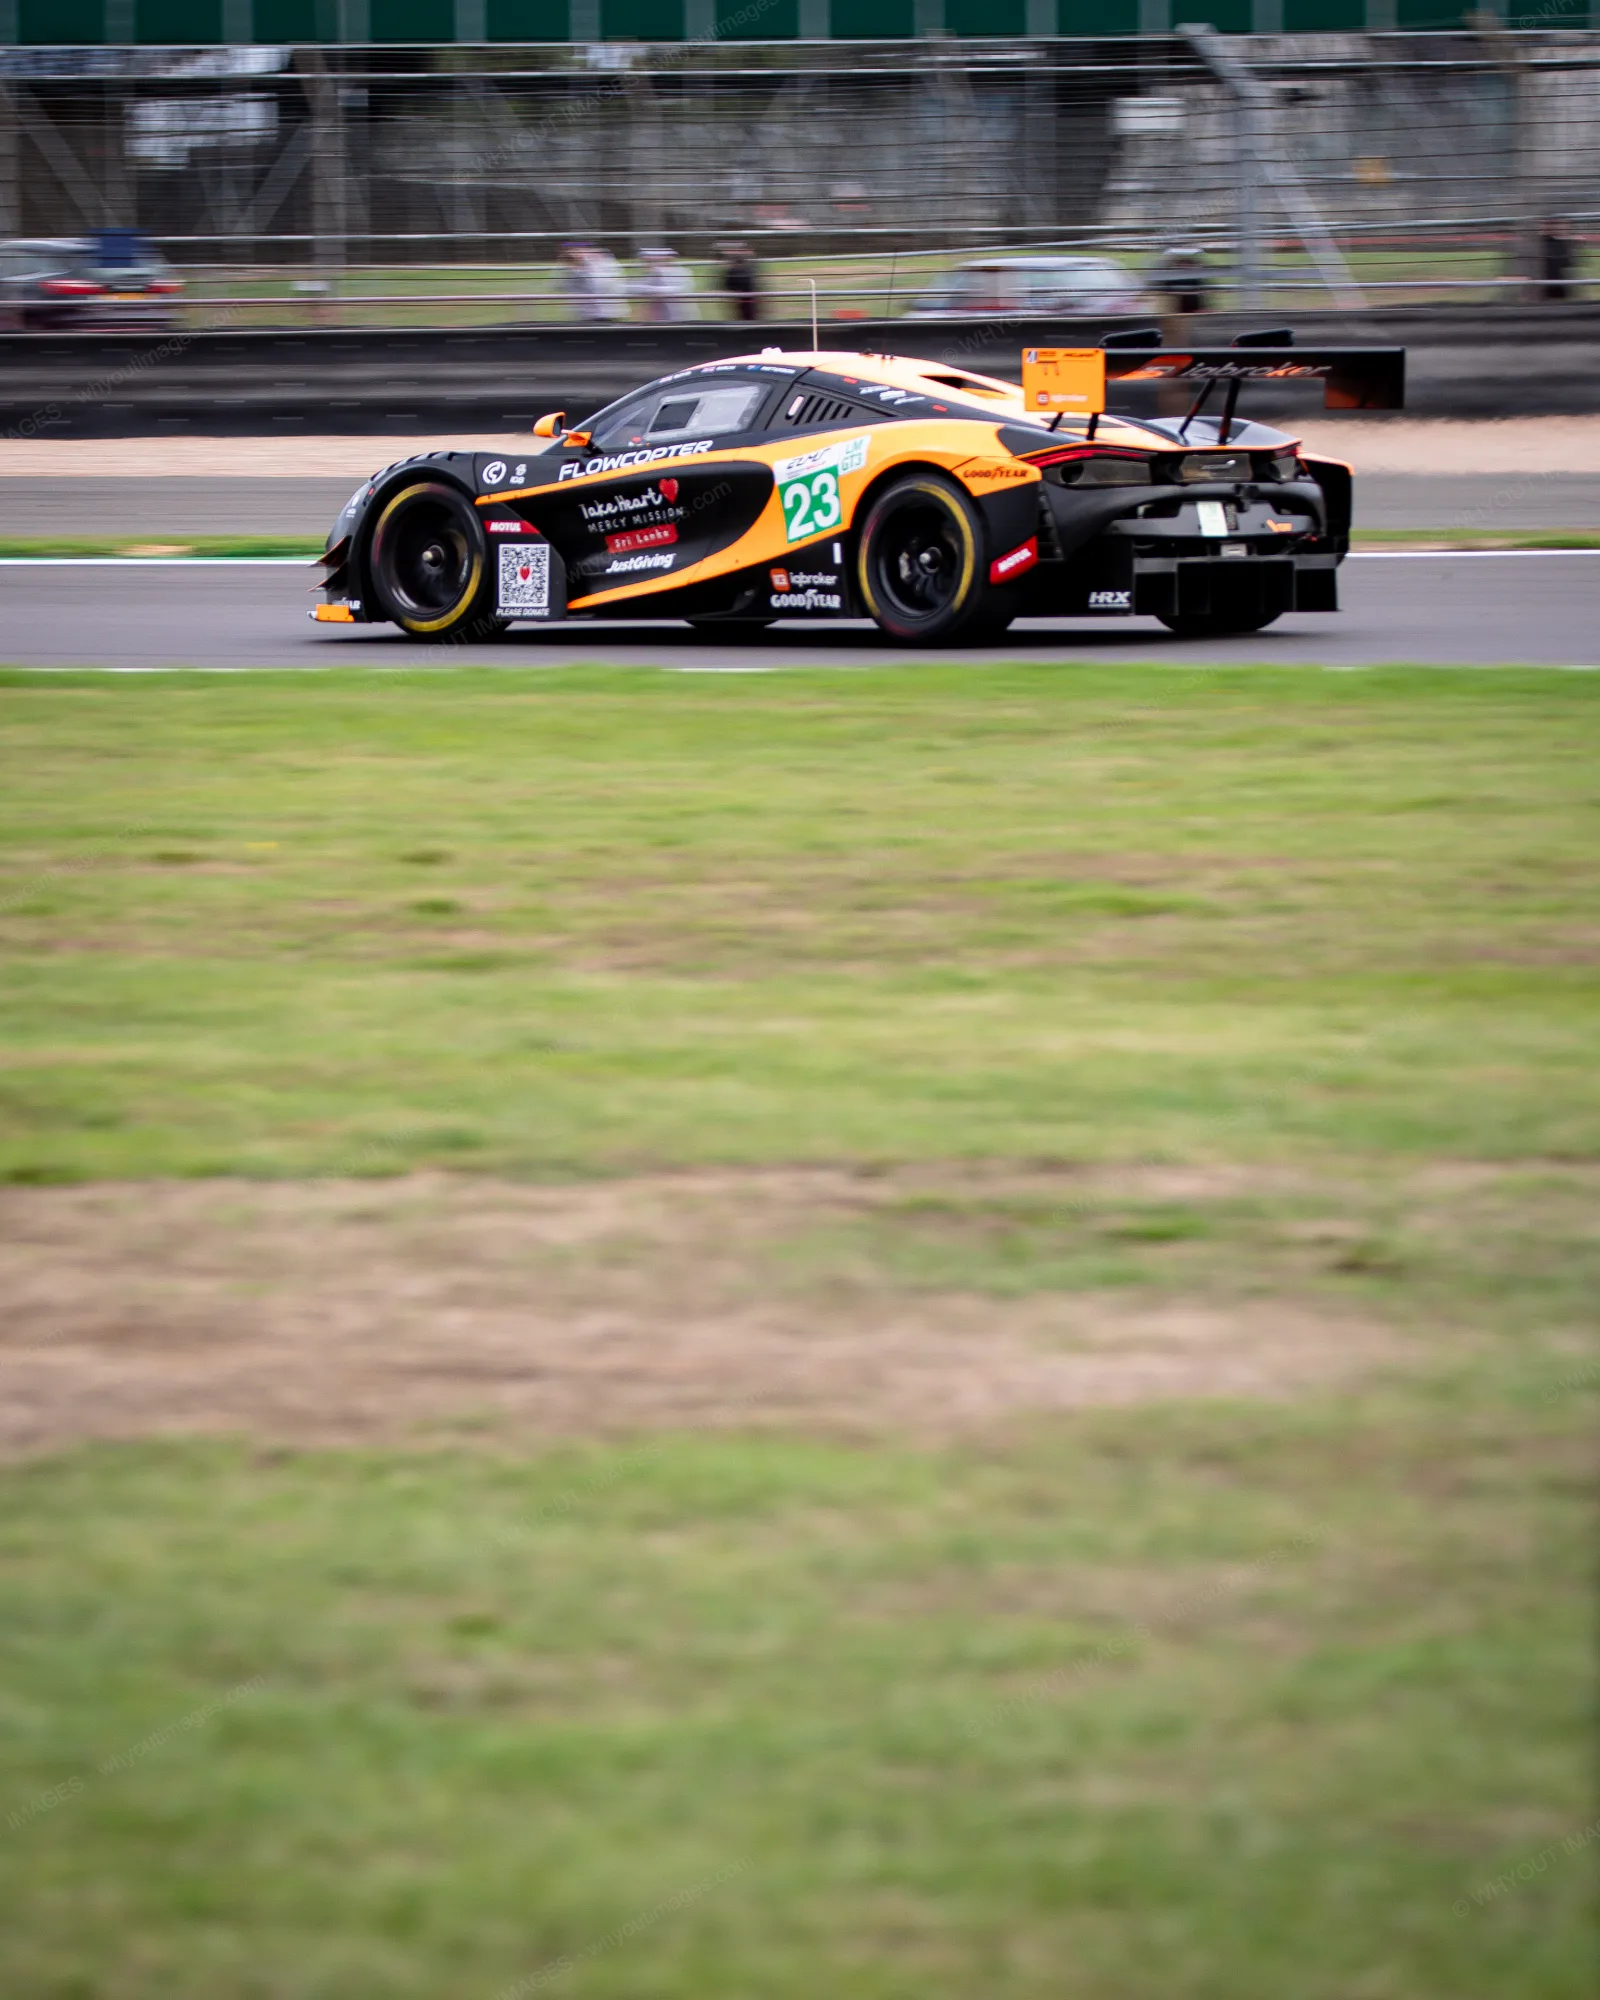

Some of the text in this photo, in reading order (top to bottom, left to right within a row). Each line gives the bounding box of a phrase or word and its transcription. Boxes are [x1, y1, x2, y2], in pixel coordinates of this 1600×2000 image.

[558, 440, 714, 481] FLOWCOPTER
[963, 466, 1028, 480] GOODYEAR
[784, 472, 841, 541] 23
[489, 522, 522, 533] MOTUL
[587, 506, 685, 533] MERCY MISSION
[614, 529, 670, 549] Sri Lanka
[605, 553, 677, 574] JustGiving
[770, 588, 841, 611] GOODYEAR
[1089, 591, 1131, 603] HRX
[495, 608, 522, 617] PLEASE
